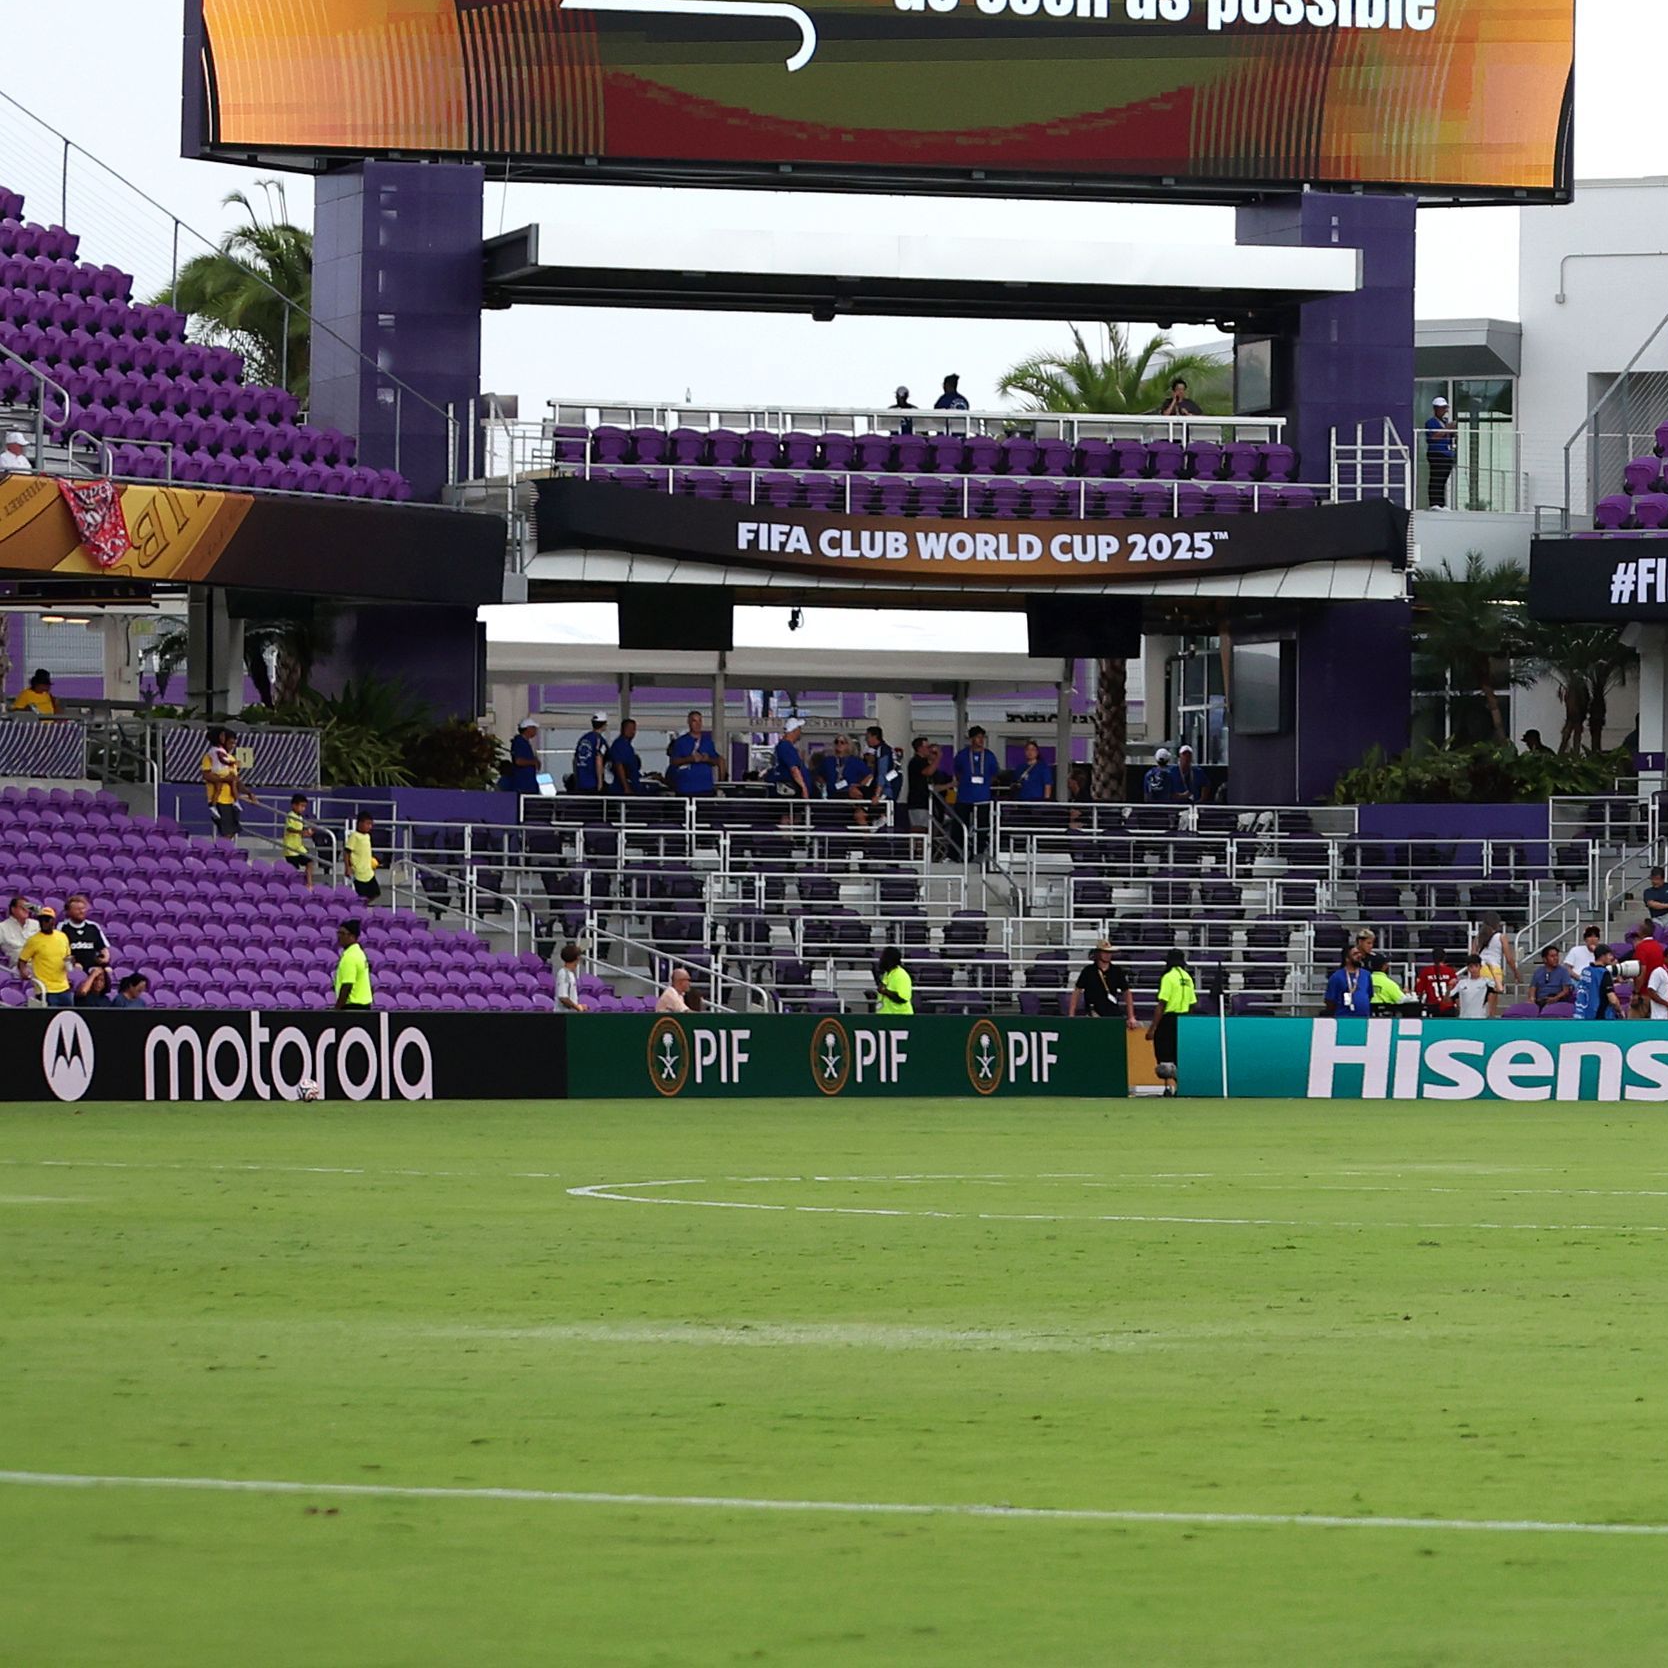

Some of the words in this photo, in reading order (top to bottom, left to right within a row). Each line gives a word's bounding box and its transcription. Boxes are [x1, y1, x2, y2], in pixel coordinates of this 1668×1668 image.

[737, 522, 812, 555] FIFA
[818, 528, 908, 560] CLUB
[914, 531, 1043, 561] WORLD
[1049, 533, 1120, 563] CUP
[1432, 981, 1448, 1001] 11
[145, 1010, 434, 1101] motorola
[694, 1028, 751, 1084] PIF
[854, 1029, 910, 1083] PIF
[1007, 1030, 1060, 1083] PIF
